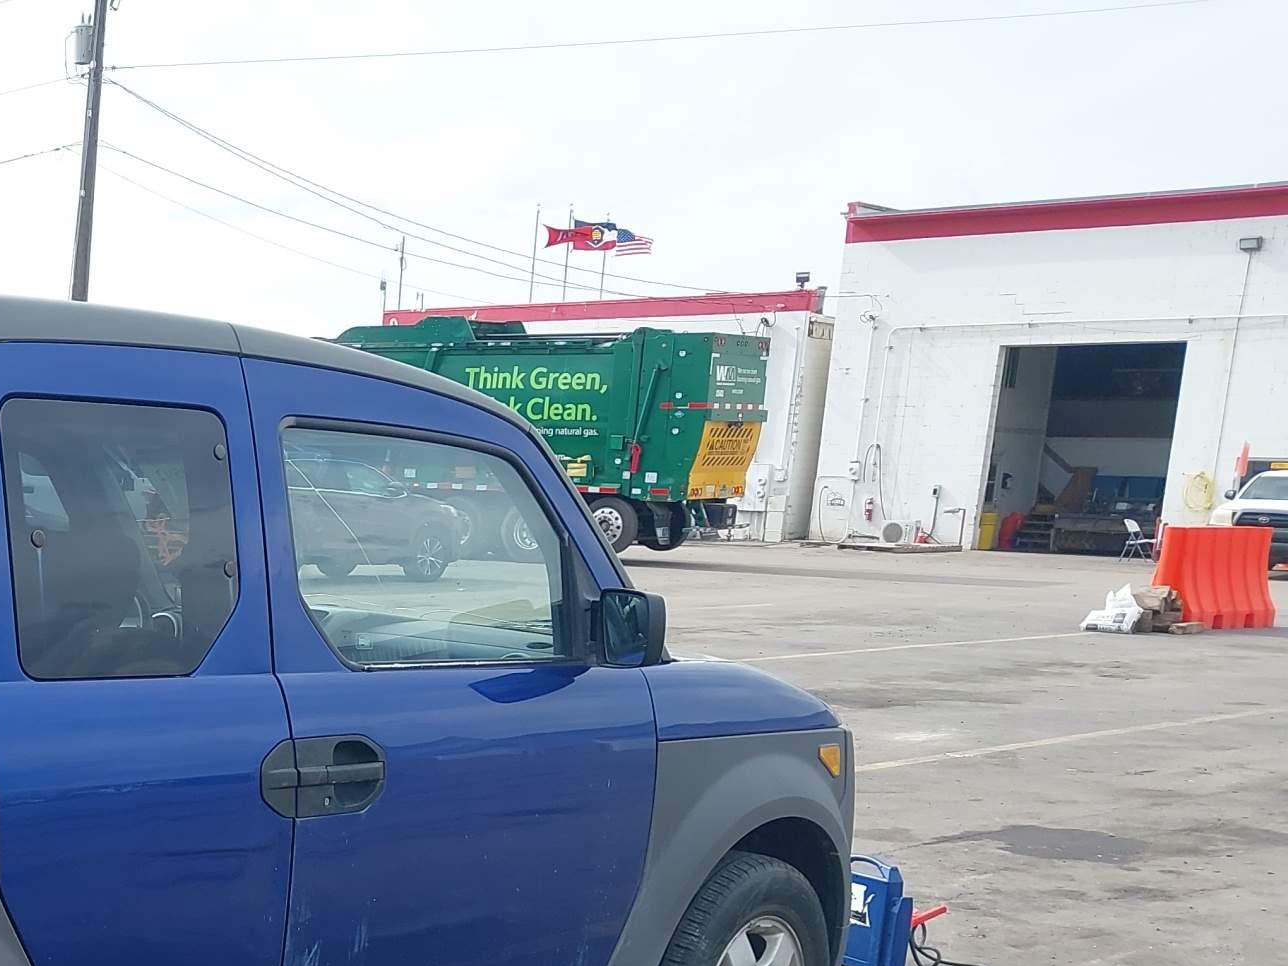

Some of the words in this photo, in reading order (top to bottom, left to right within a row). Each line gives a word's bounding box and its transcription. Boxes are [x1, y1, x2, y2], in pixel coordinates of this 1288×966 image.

[465, 366, 526, 389] Think
[530, 367, 608, 394] Green,
[527, 396, 597, 421] Clean.
[555, 427, 581, 436] natural
